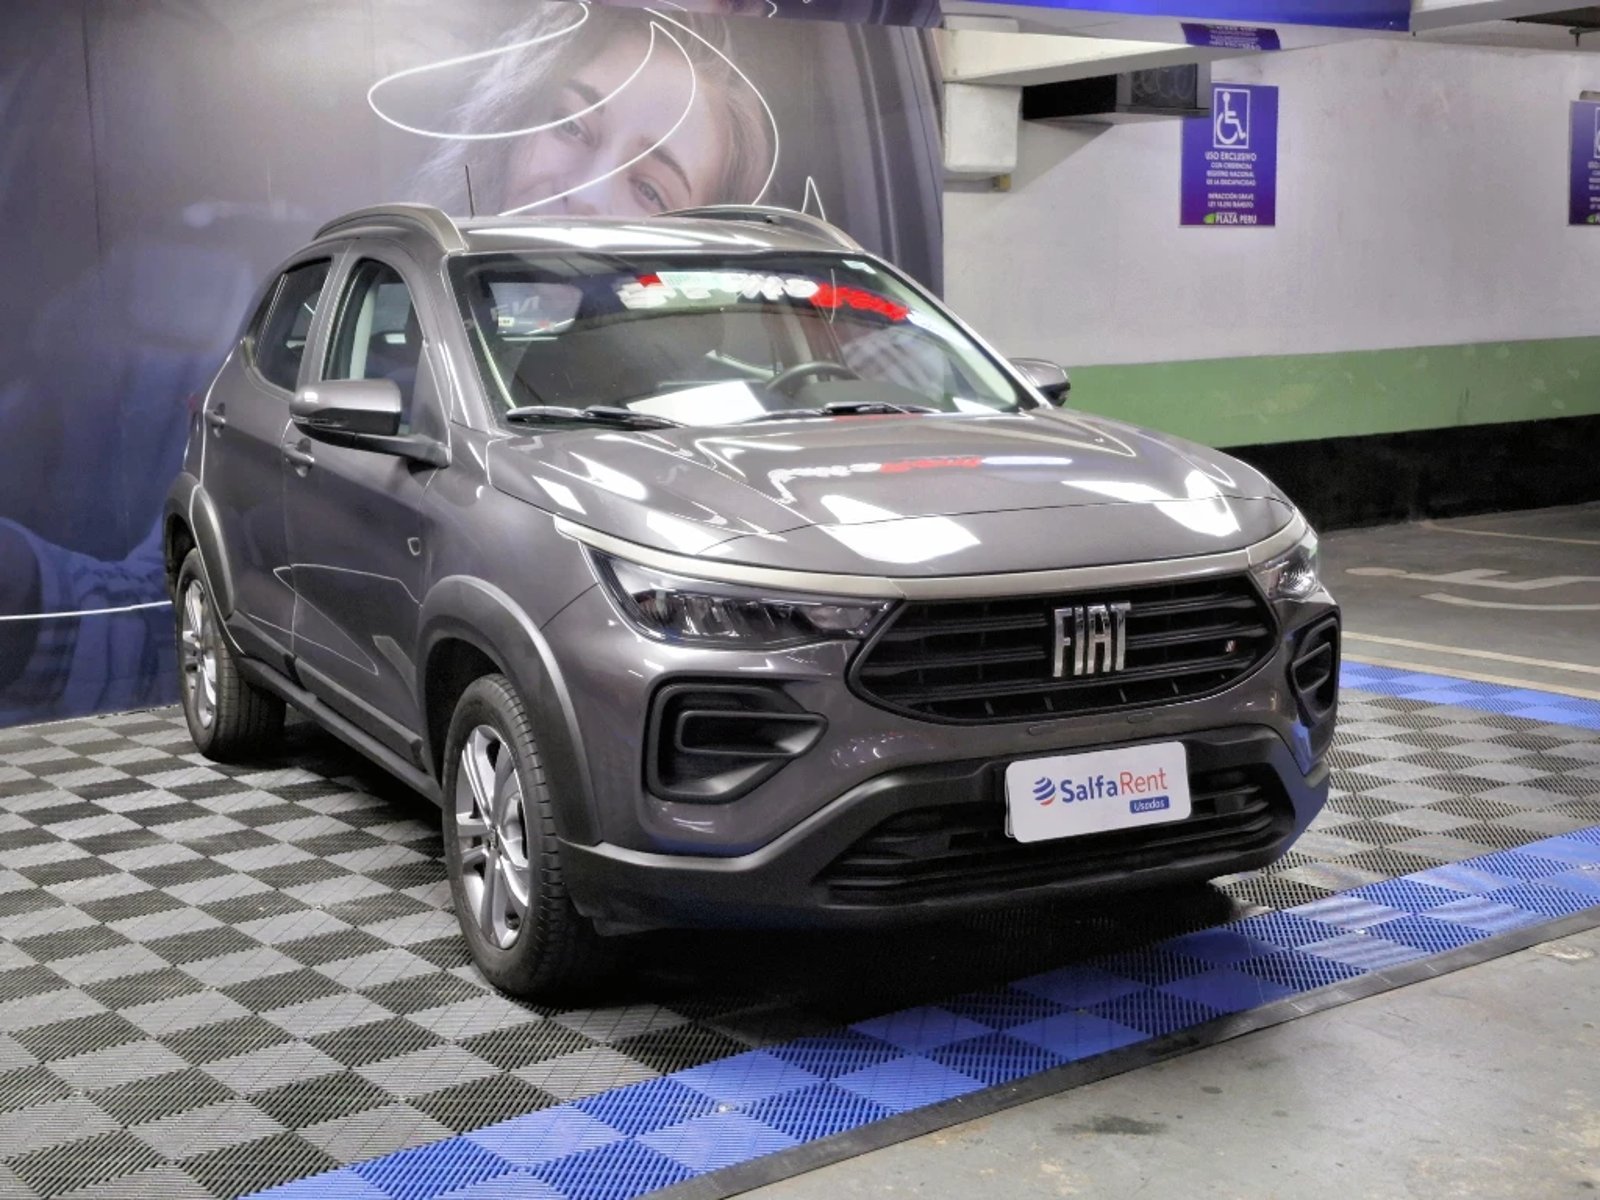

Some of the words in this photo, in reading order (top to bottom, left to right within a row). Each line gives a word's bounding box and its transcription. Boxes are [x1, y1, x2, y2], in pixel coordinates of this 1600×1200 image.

[1205, 151, 1219, 160] USO
[1220, 152, 1257, 161] EXCLUSIVO
[1215, 213, 1238, 224] PLAZA
[1053, 601, 1131, 677] FIAT
[1060, 767, 1168, 803] SalfaRent
[1133, 799, 1165, 812] Usados
